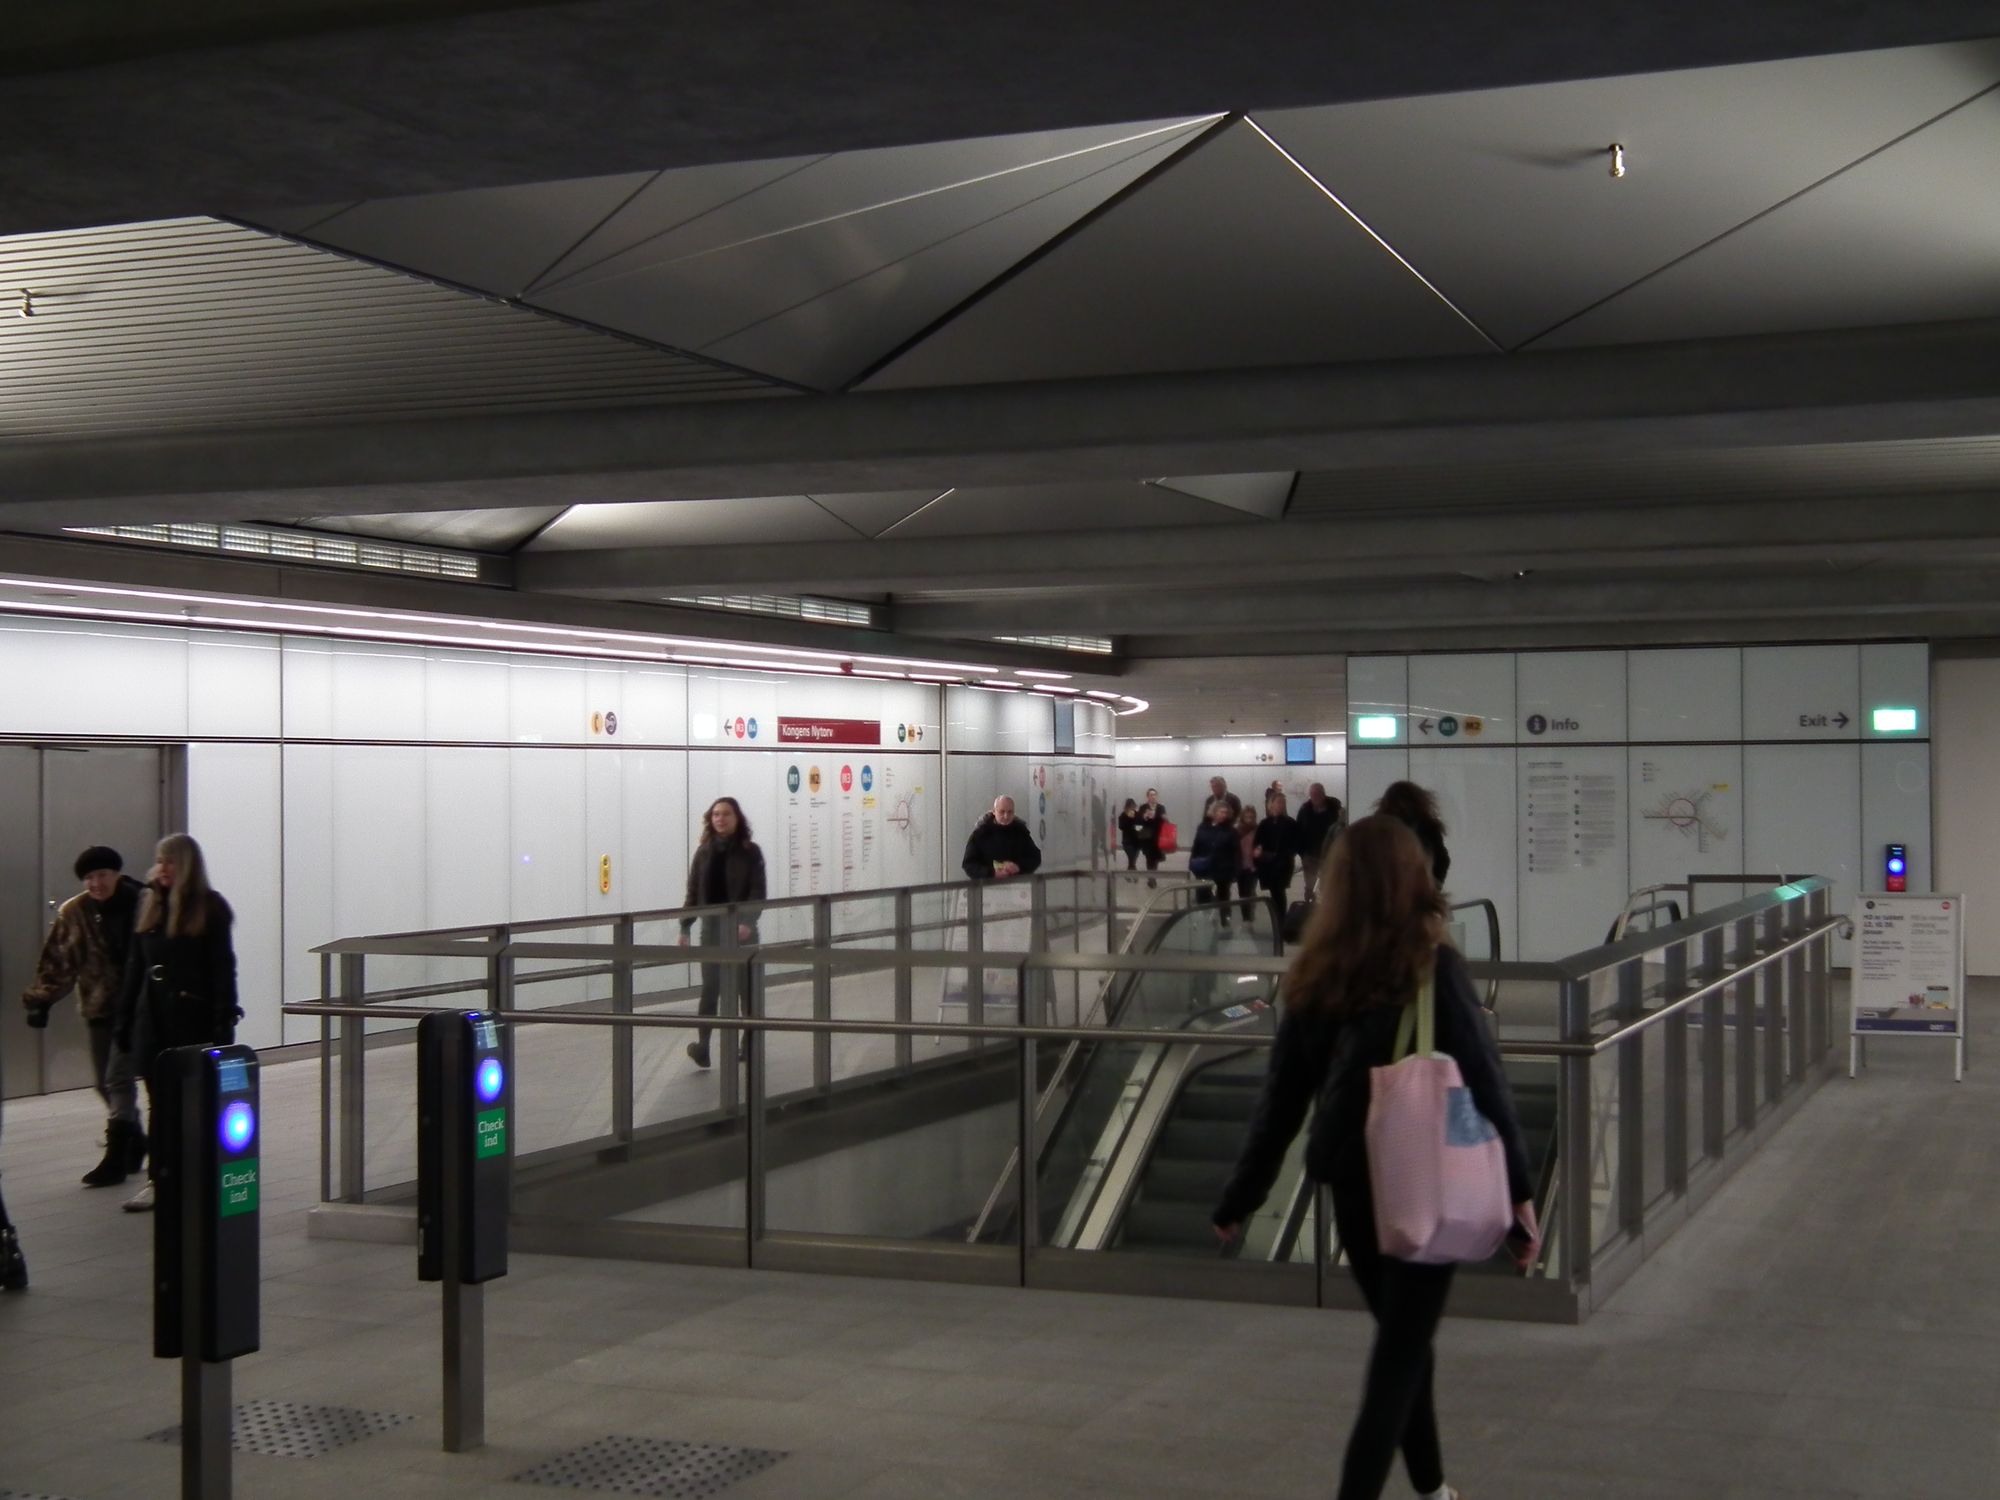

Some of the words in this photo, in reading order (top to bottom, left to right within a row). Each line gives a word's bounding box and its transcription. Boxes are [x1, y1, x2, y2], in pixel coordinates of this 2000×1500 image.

[1441, 721, 1456, 731] M1
[1465, 720, 1481, 731] M2
[1551, 718, 1580, 731] Info
[1800, 714, 1828, 727] Exit
[782, 724, 810, 740] Kongens
[811, 725, 833, 740] Nytorv
[788, 773, 798, 785] M1
[841, 772, 851, 784] M3
[478, 1117, 504, 1134] Check
[484, 1133, 499, 1147] ind
[222, 1168, 257, 1188] Check
[229, 1188, 249, 1204] ind
